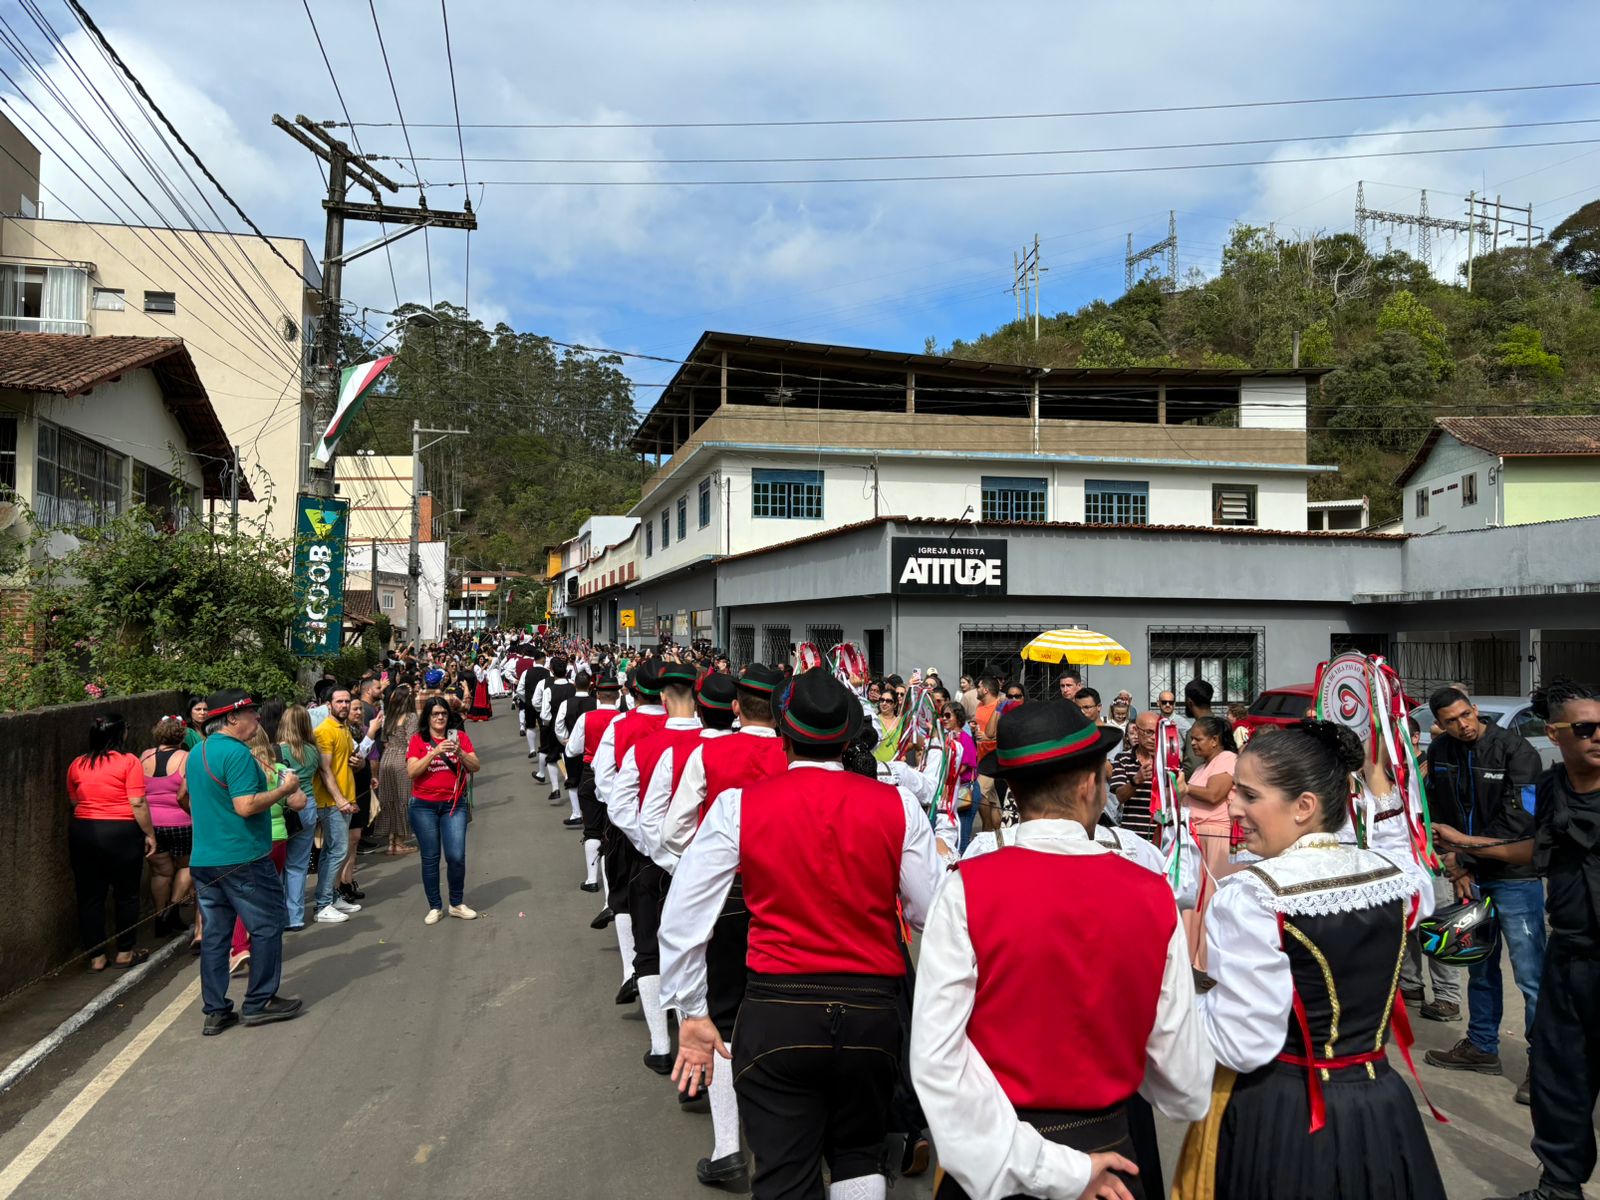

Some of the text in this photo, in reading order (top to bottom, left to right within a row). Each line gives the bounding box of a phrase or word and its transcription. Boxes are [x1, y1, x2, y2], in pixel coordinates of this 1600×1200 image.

[918, 547, 948, 555] IGREJA
[899, 557, 1001, 585] ATITUDE
[1345, 663, 1360, 672] PAVÃO
